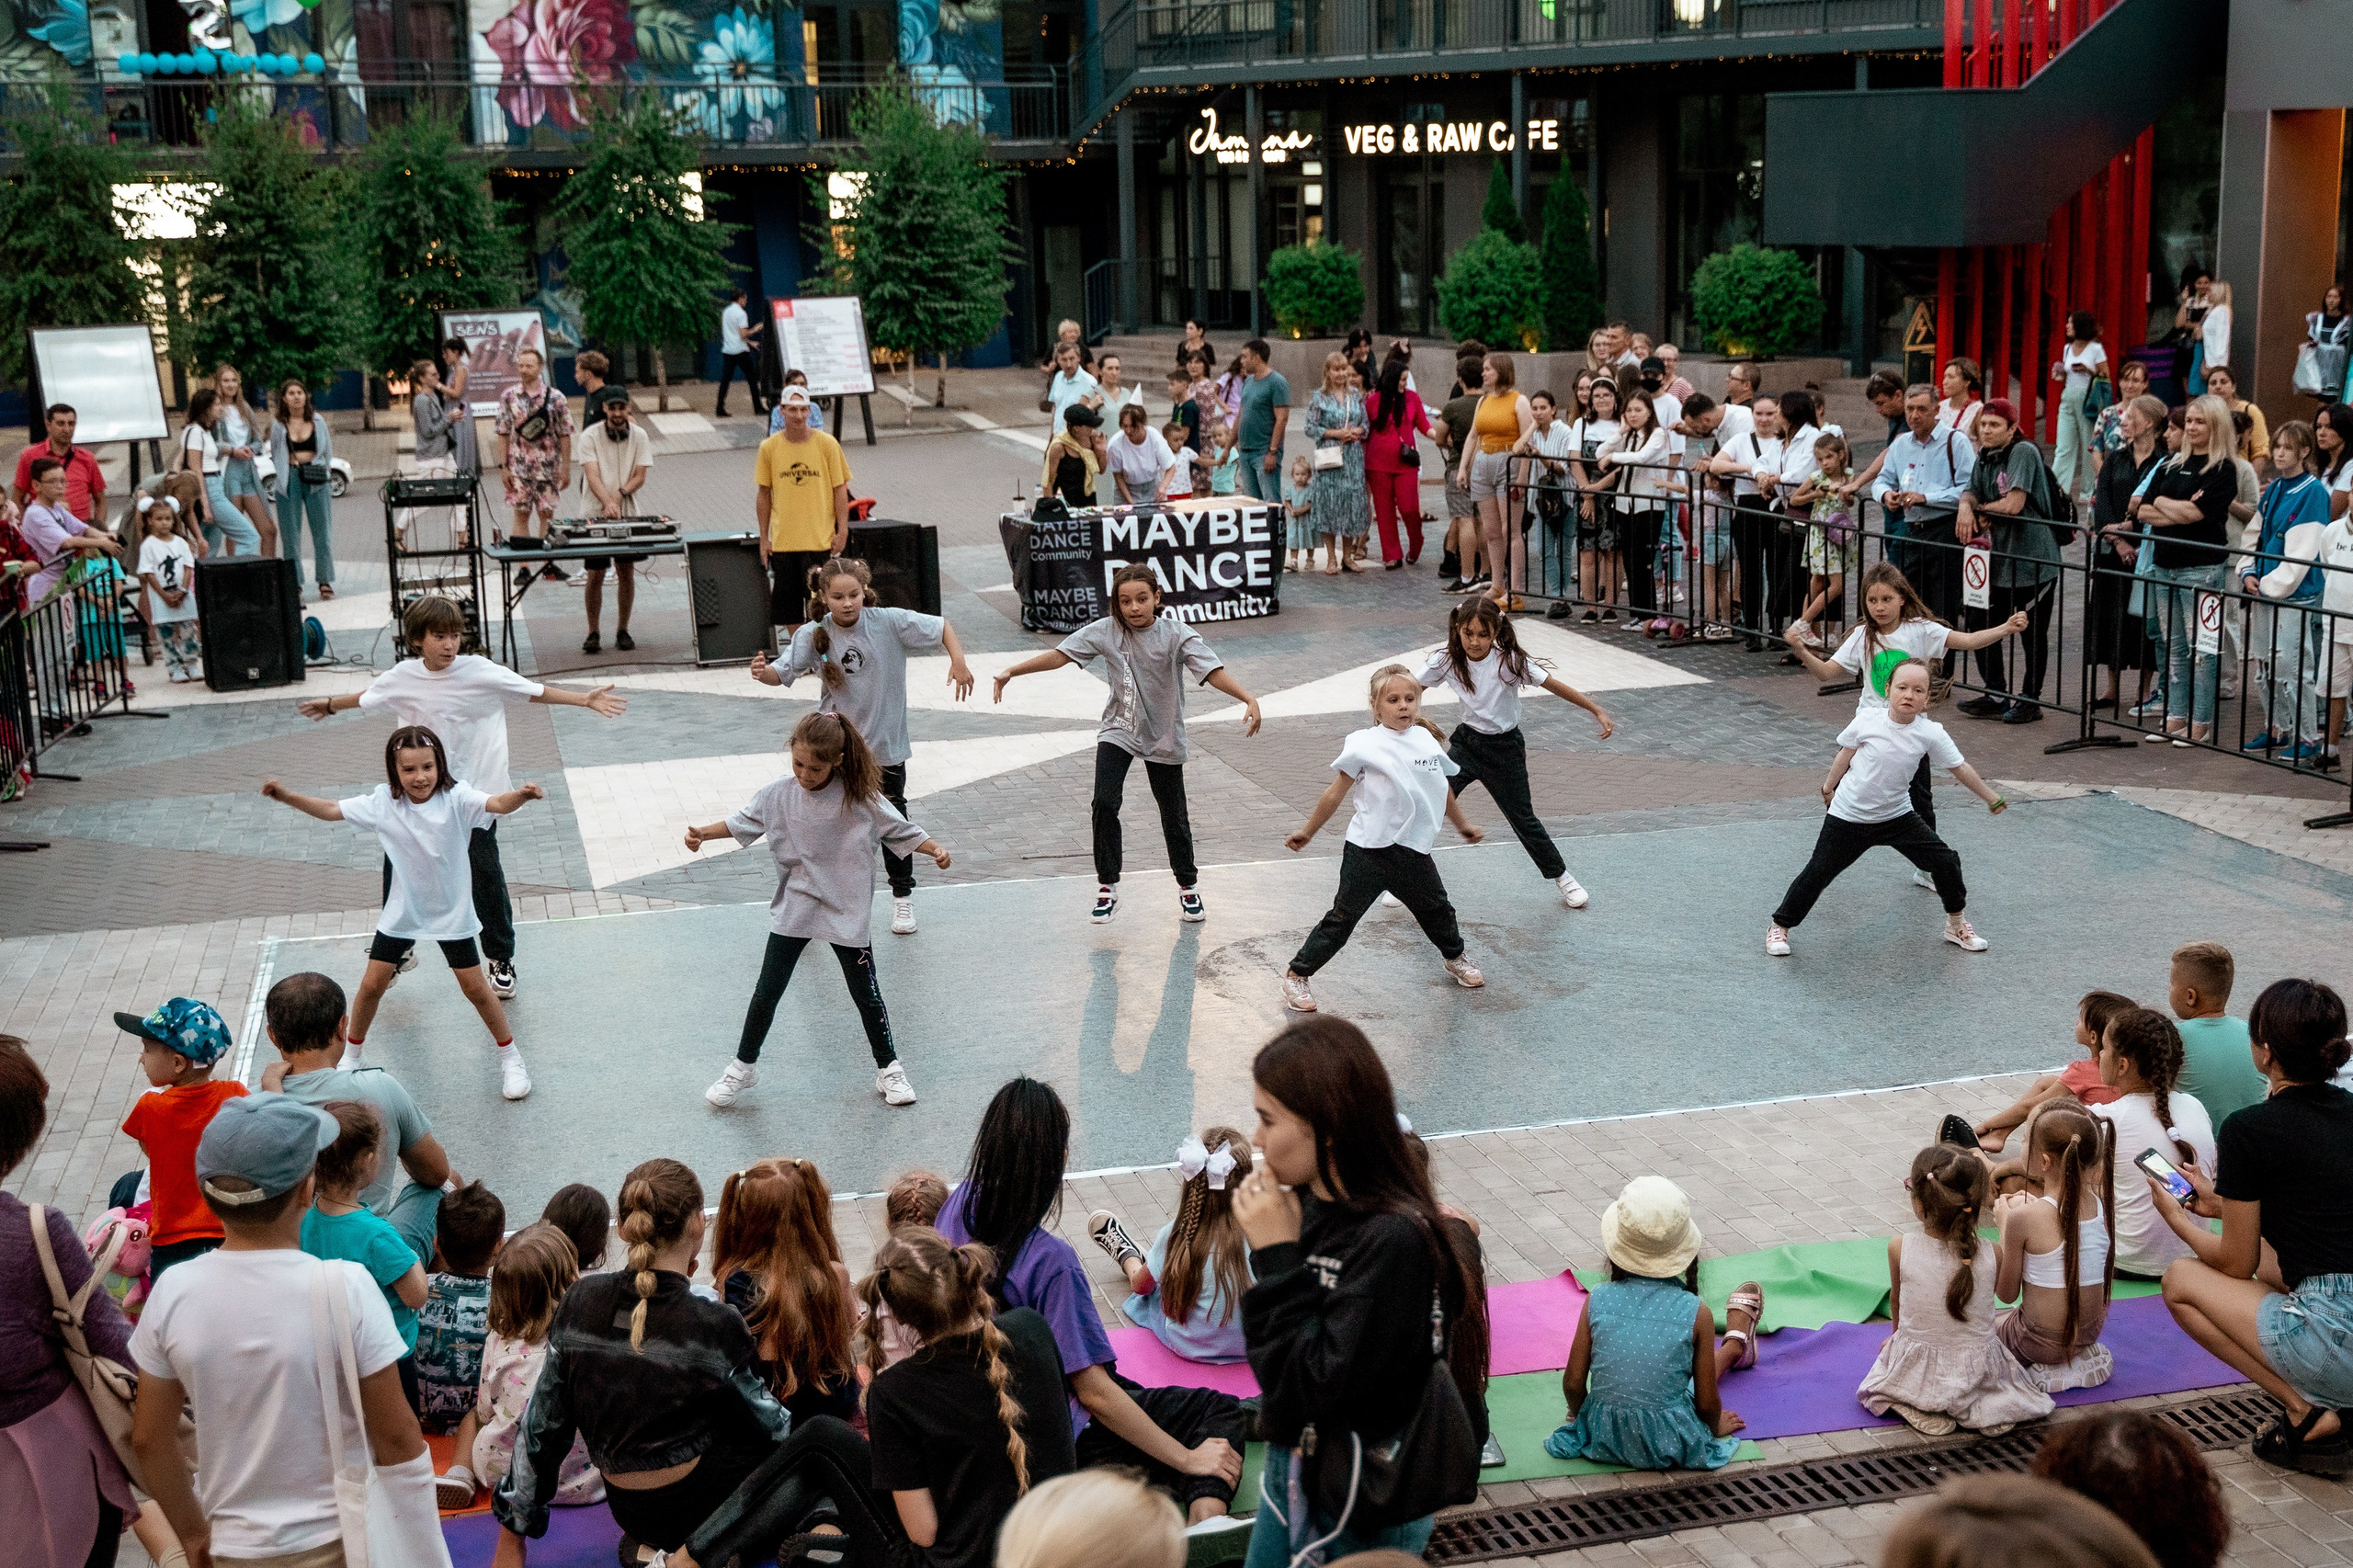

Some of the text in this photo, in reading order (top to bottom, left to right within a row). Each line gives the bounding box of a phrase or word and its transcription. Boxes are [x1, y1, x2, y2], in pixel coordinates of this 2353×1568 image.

[1189, 108, 1313, 154] Jamna
[1344, 119, 1559, 154] VEG & RAW CFE
[779, 470, 821, 478] UNIVERSAL
[1102, 506, 1271, 551] MAYBE
[1029, 532, 1092, 550] DANCE
[1030, 549, 1092, 562] Community
[1034, 587, 1097, 605] MAYBE
[1036, 603, 1099, 619] DANCE
[1162, 593, 1270, 623] mmunity
[1124, 665, 1133, 699] SCHOO
[1113, 716, 1133, 733] MDC
